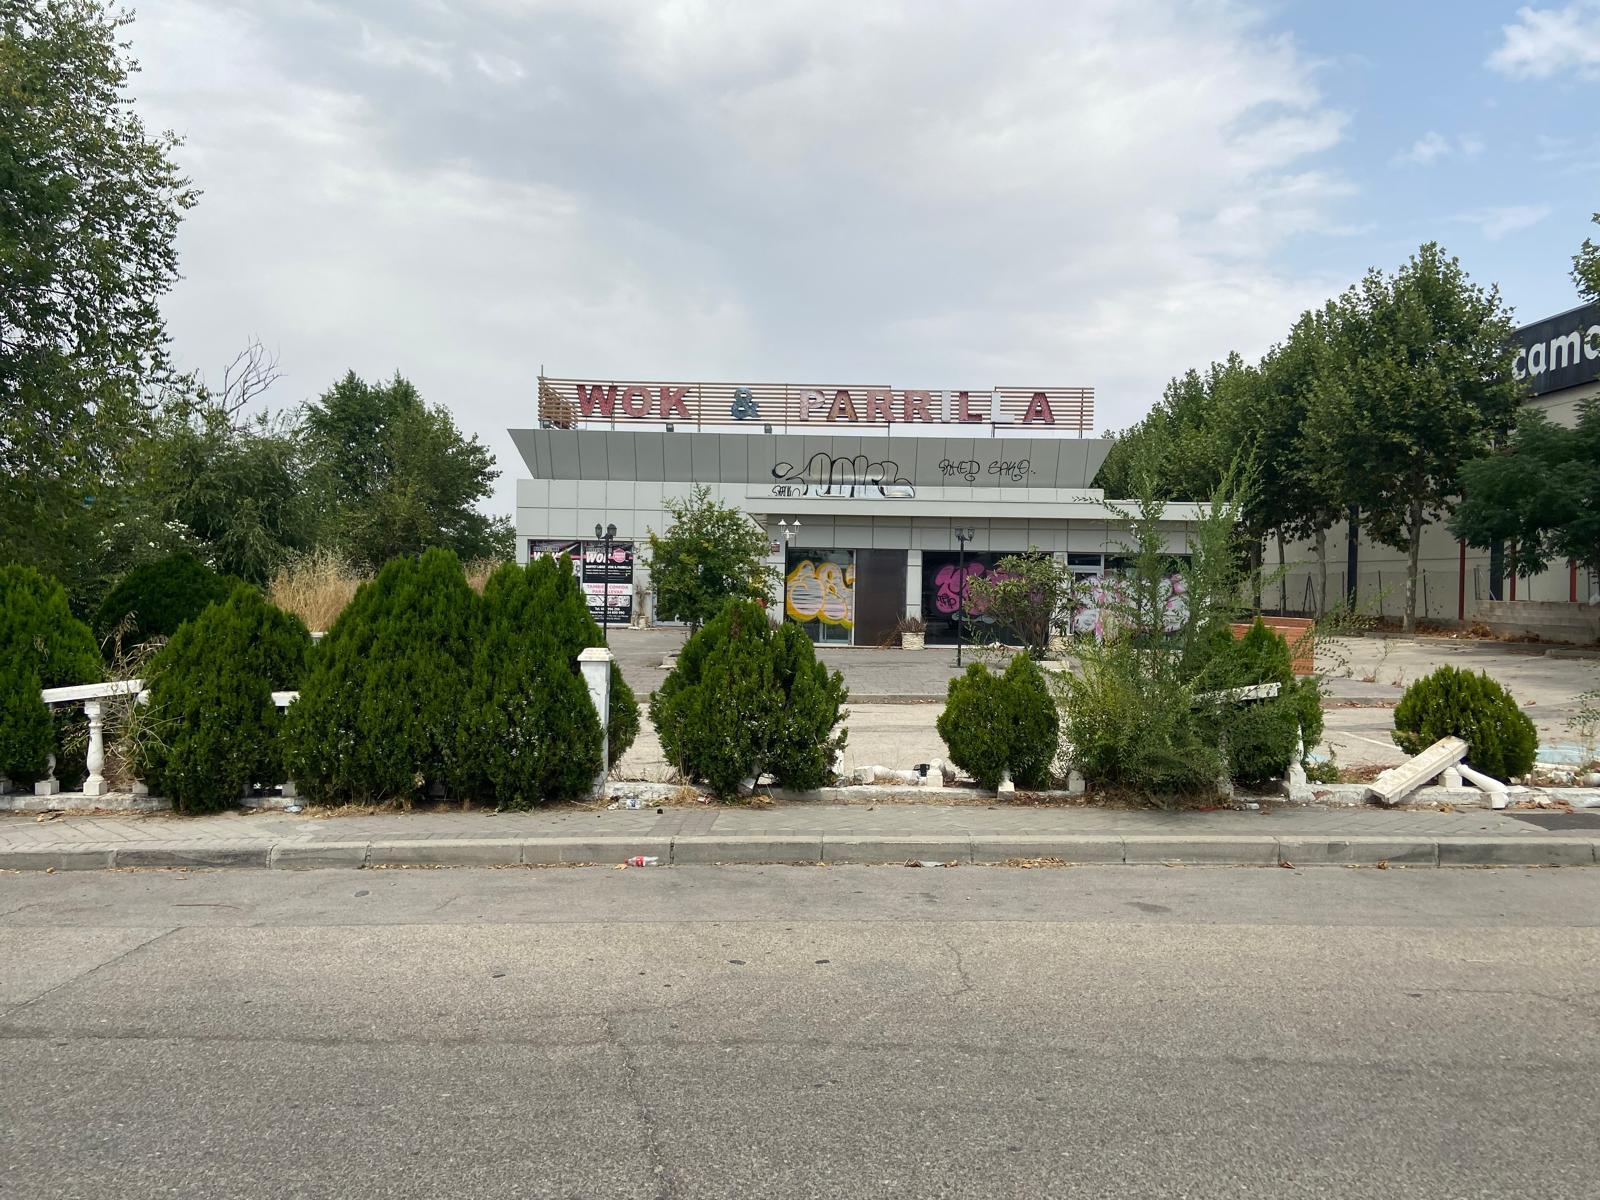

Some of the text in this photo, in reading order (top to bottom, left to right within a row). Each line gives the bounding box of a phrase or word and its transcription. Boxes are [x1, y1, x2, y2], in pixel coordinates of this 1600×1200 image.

[576, 384, 1055, 424] WOK & PARRILLA
